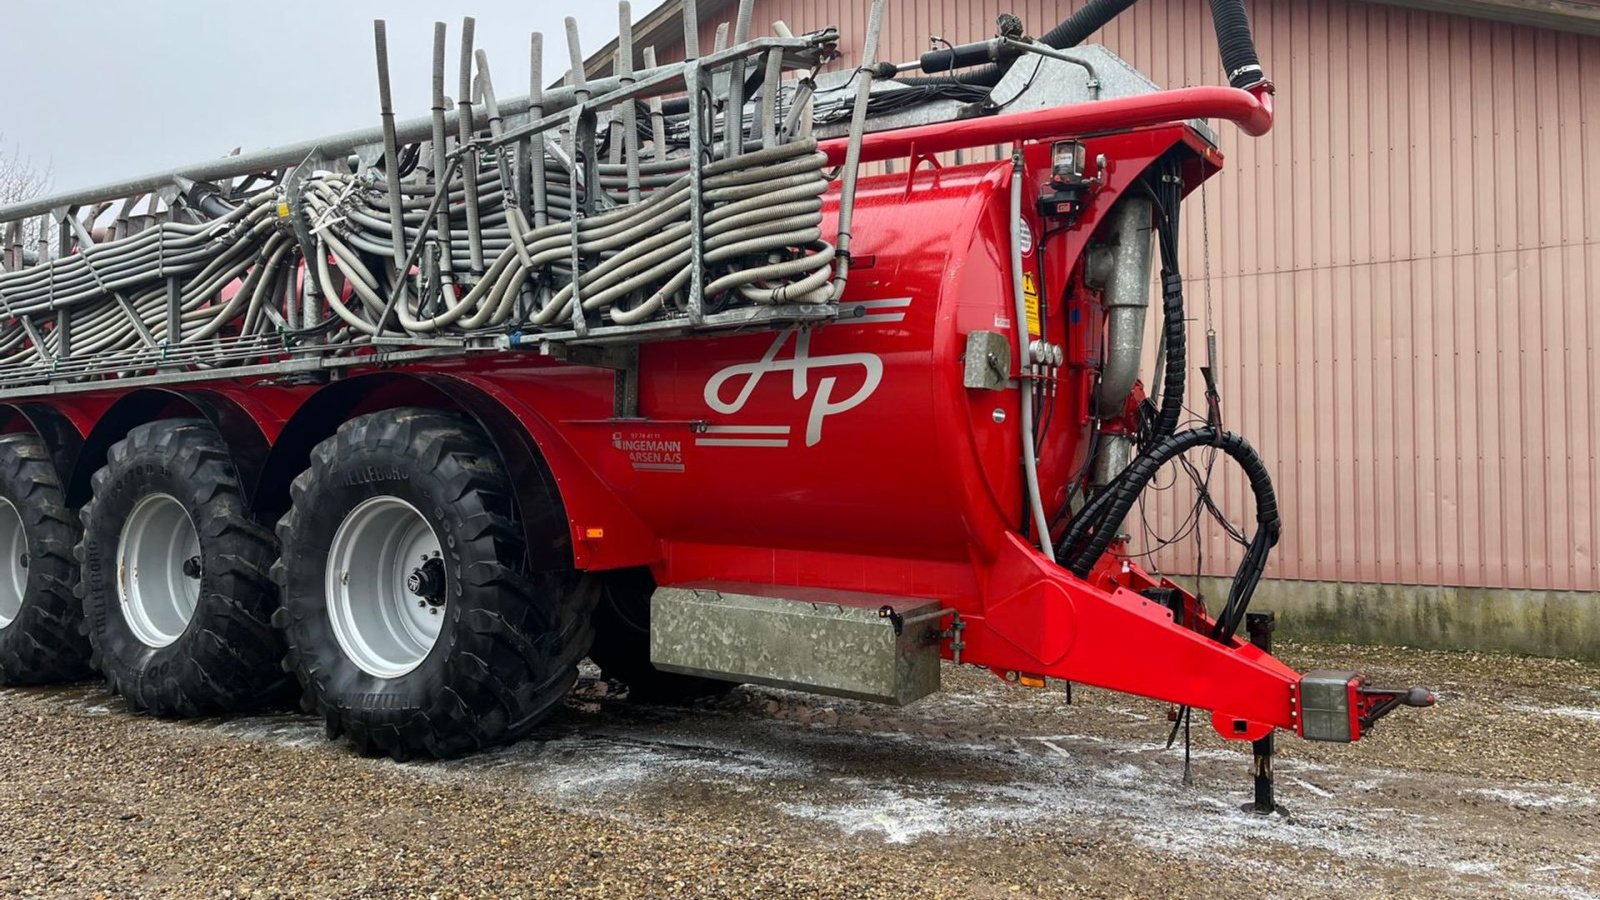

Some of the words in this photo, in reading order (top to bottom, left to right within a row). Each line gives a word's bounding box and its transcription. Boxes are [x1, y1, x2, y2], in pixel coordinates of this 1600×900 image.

[703, 326, 884, 447] AP
[623, 440, 681, 452] INGEMANN
[629, 452, 661, 463] ARSEN
[663, 453, 682, 463] A/S
